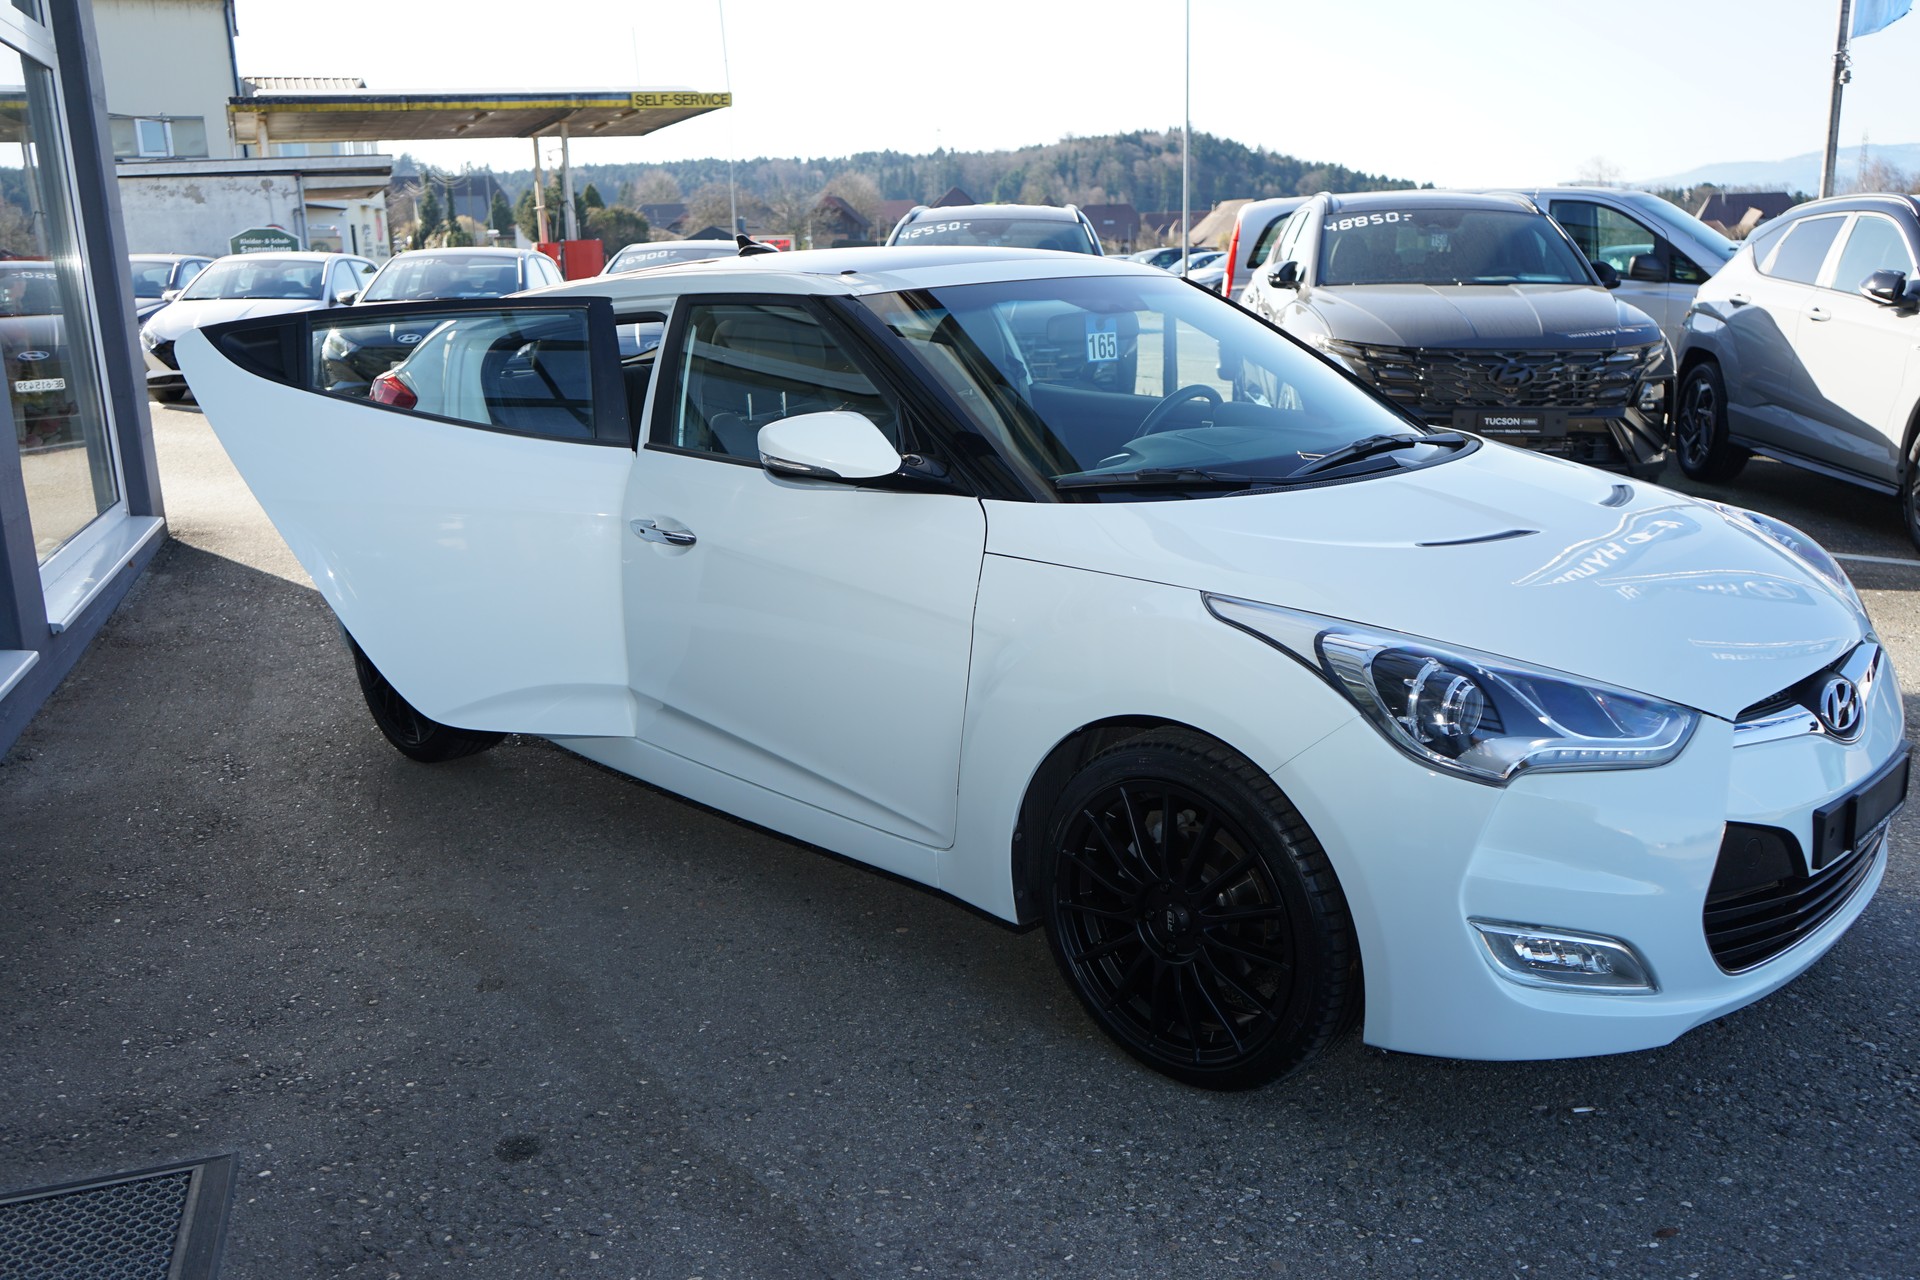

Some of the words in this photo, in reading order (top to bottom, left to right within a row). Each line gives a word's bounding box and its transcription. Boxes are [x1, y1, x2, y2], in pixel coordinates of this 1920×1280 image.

[635, 93, 730, 107] SELF-SERVICE
[1089, 334, 1116, 359] 165
[1484, 417, 1521, 426] TUCSON
